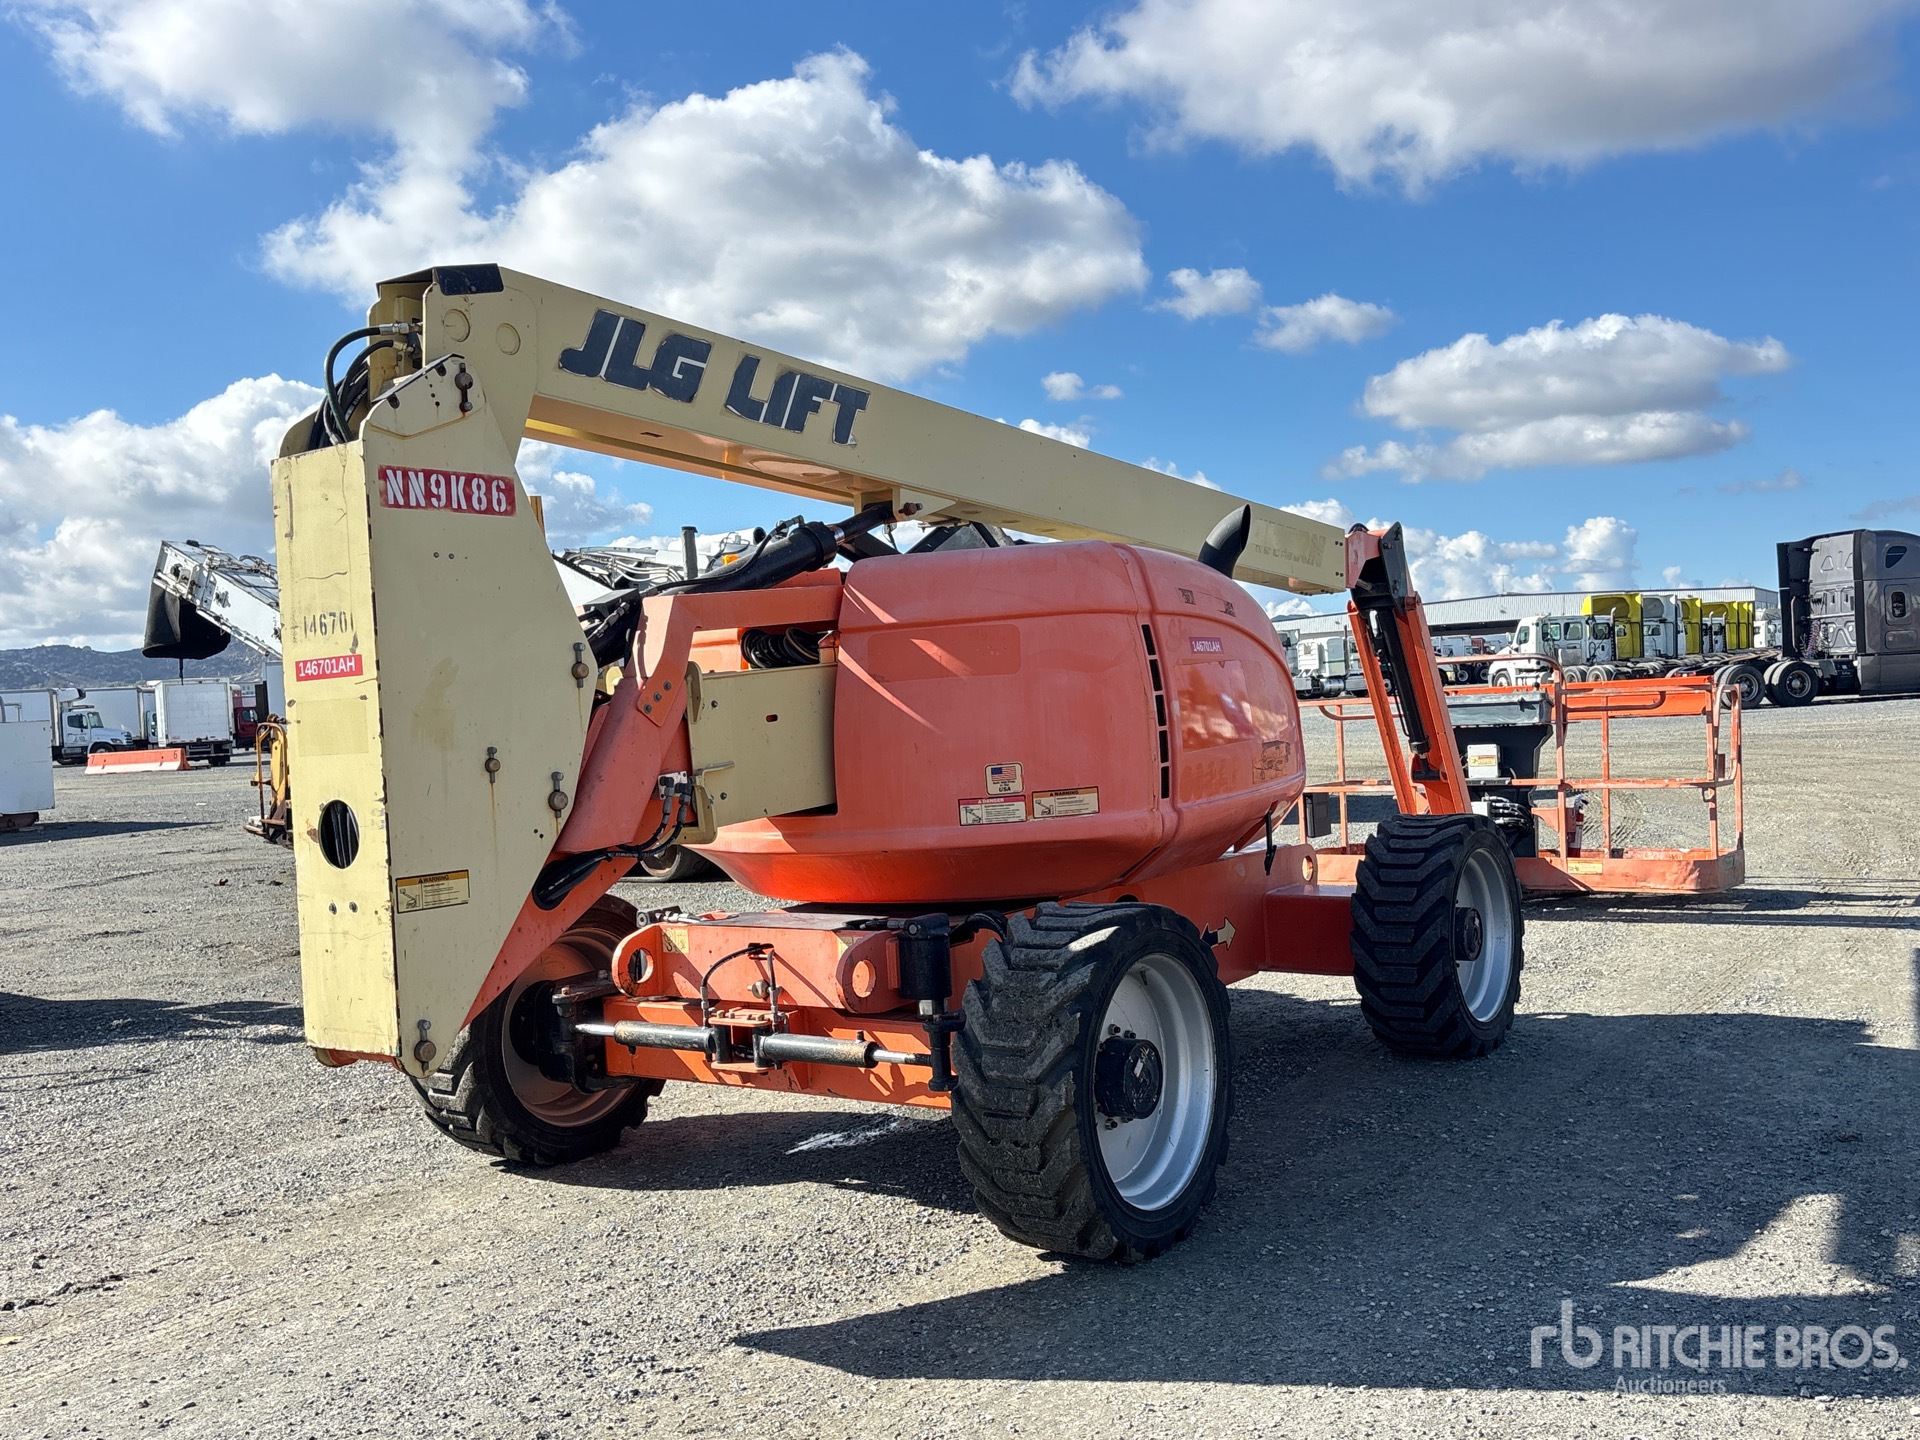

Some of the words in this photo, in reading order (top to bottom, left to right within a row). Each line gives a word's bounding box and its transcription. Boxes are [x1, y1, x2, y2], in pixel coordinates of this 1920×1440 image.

[558, 309, 712, 403] JLG
[724, 354, 870, 445] LIFT
[386, 469, 507, 513] NN9K86
[303, 610, 354, 639] 146701
[1192, 640, 1221, 652] 146701AH
[298, 656, 356, 677] 146701AH
[422, 875, 450, 884] WARNING
